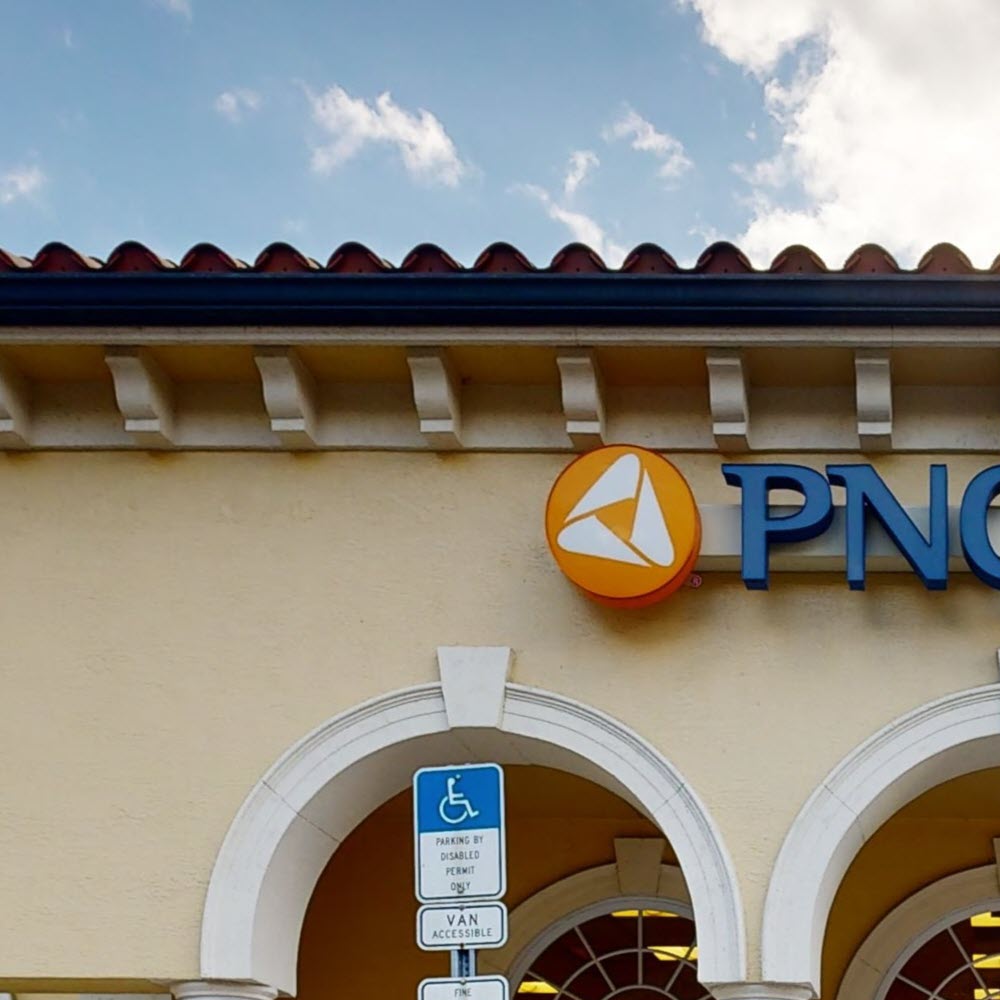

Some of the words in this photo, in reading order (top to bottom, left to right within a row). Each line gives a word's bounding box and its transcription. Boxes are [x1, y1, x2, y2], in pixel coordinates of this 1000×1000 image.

[436, 836, 470, 846] PARKING
[473, 835, 484, 844] BY
[440, 850, 480, 861] DISABLED
[446, 866, 475, 876] PERMIT
[450, 882, 471, 891] ONLY
[446, 913, 478, 927] VAN
[432, 928, 493, 939] ACCESSIBLE
[454, 988, 472, 997] FINE
